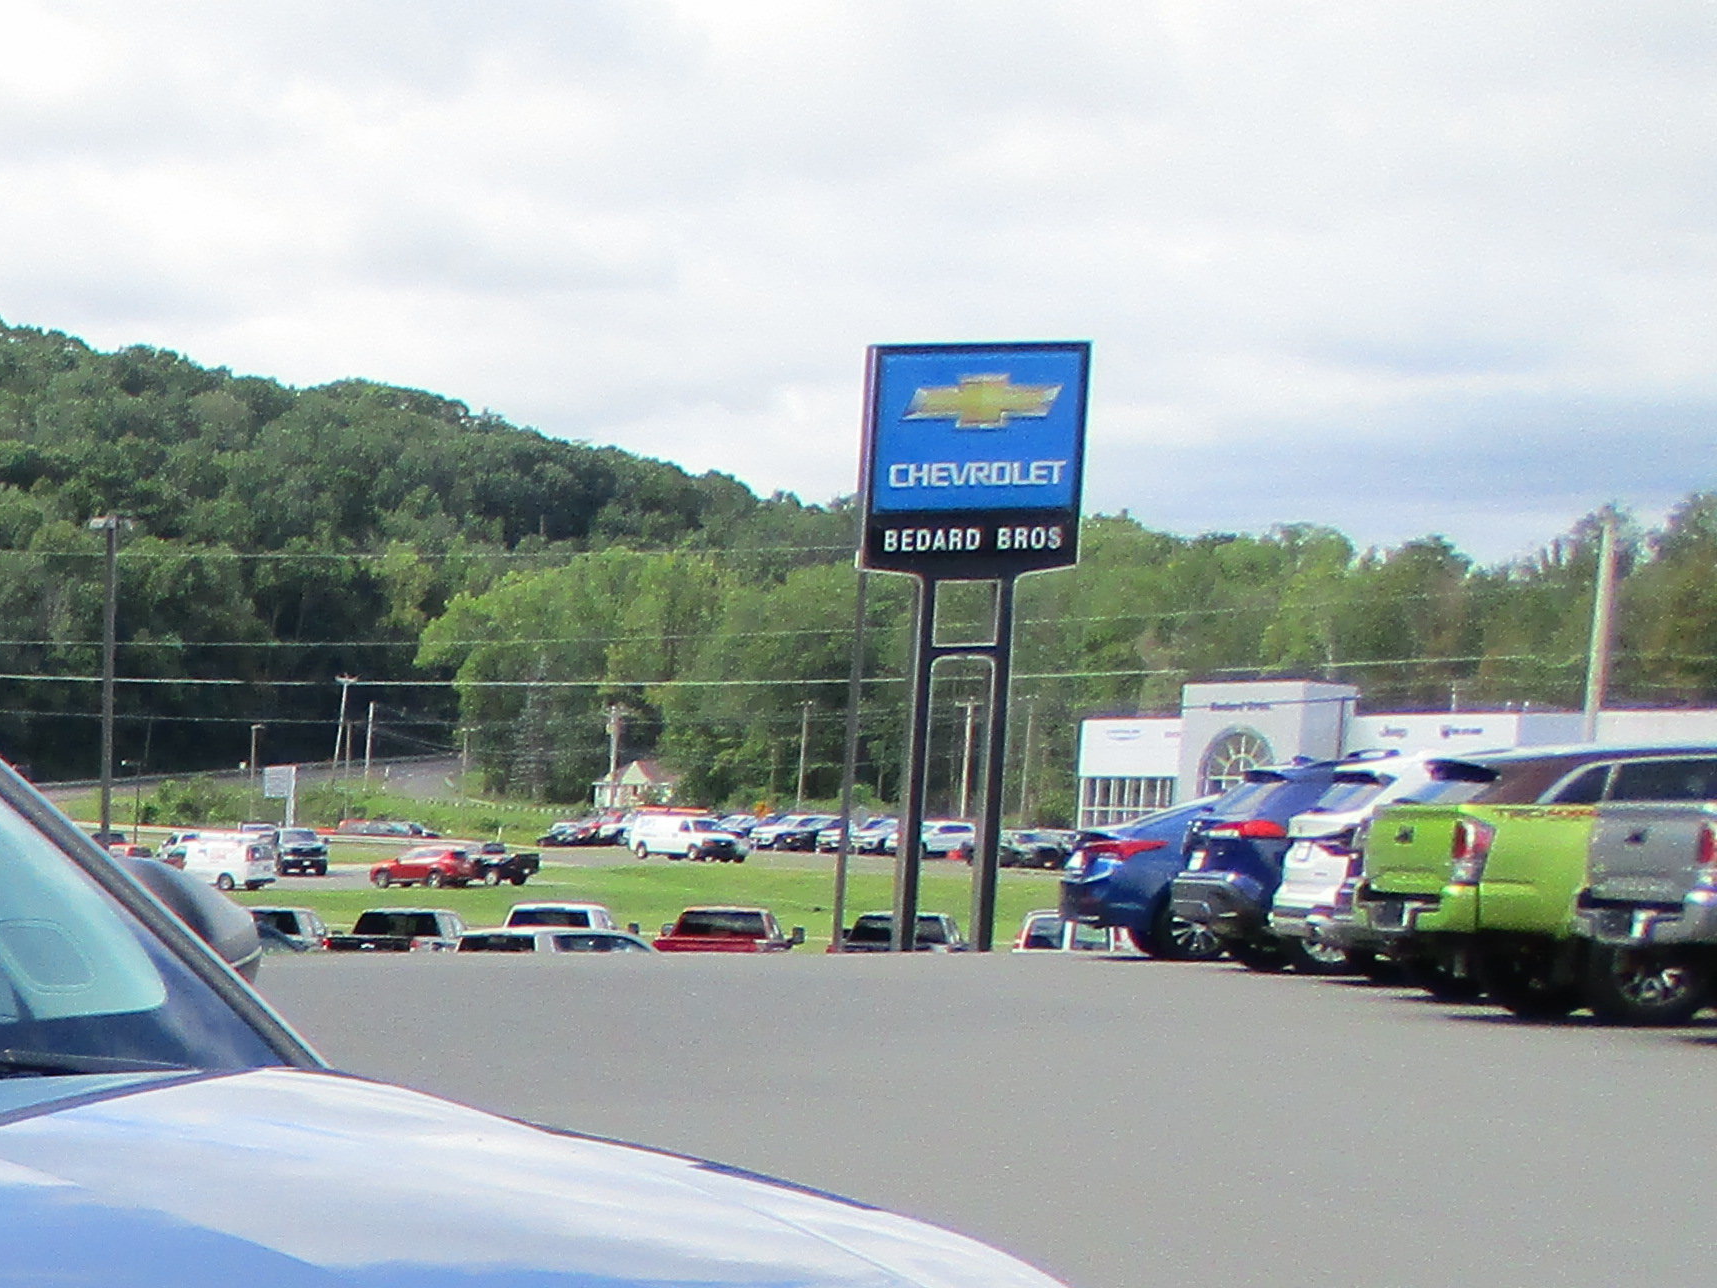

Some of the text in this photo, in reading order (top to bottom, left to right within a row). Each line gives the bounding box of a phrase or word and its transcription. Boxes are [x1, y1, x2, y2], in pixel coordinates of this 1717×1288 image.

[888, 460, 1067, 488] CHEVROLET
[883, 526, 1063, 552] BEDARD BROS
